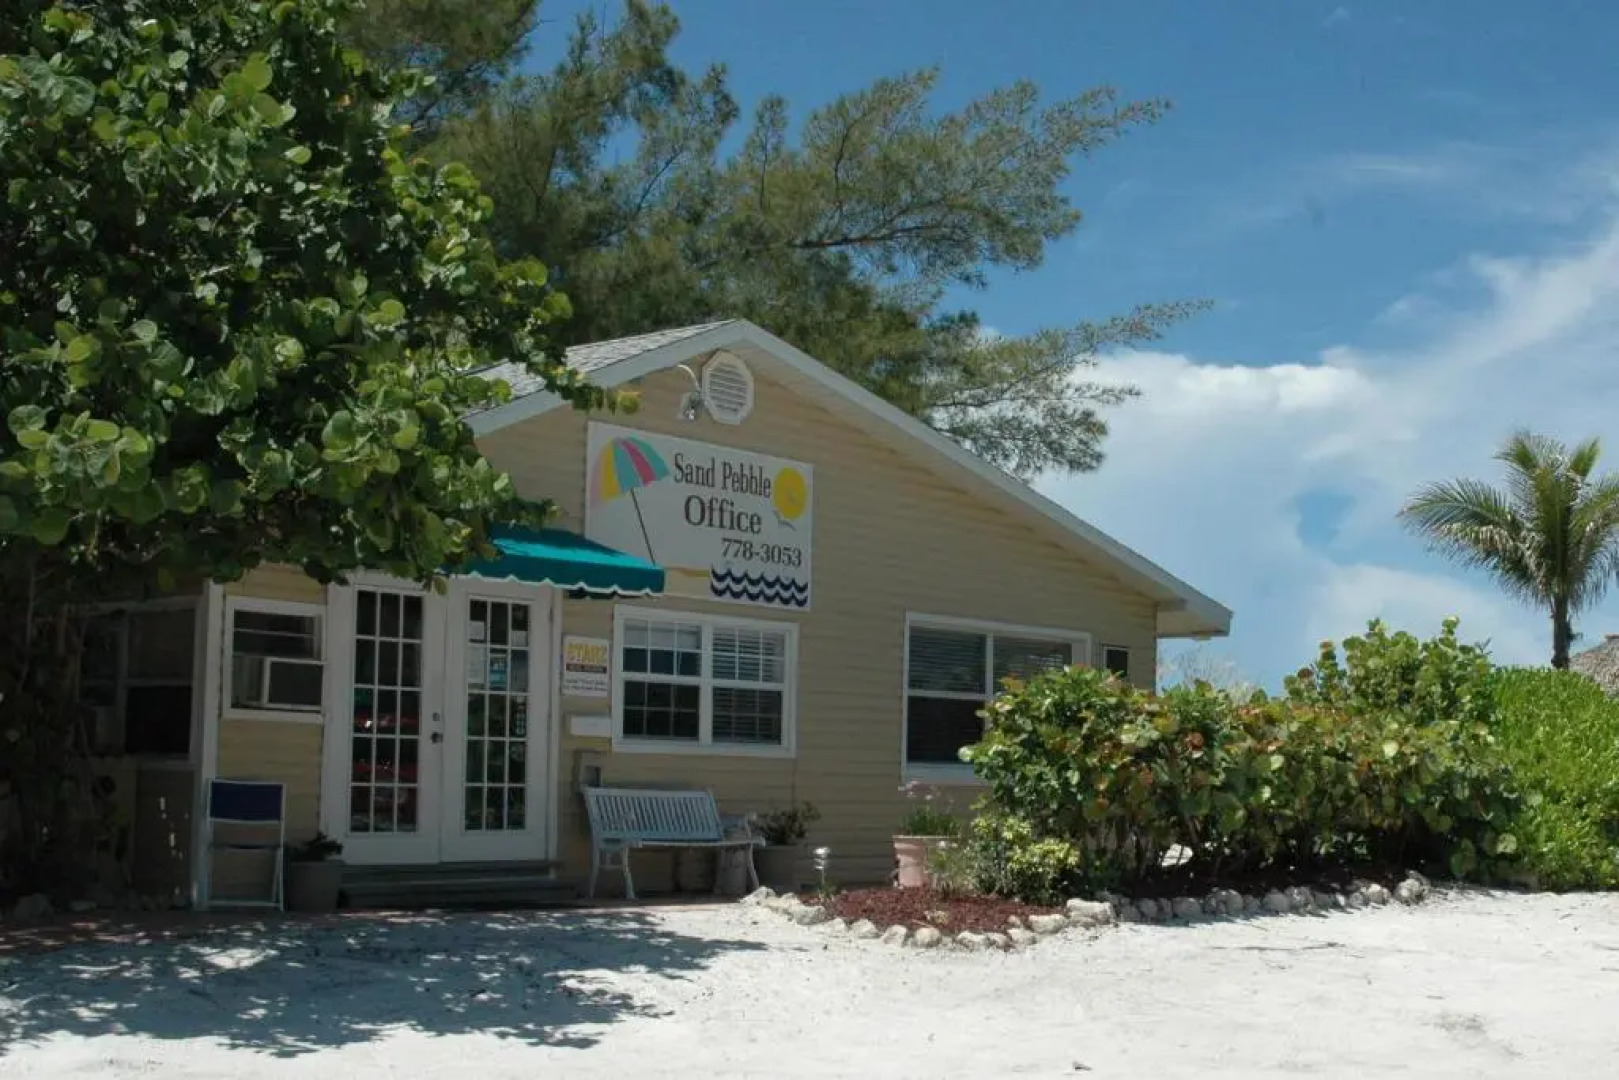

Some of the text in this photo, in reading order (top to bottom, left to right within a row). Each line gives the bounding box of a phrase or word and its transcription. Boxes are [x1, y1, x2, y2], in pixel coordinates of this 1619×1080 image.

[673, 453, 771, 498] Sand Pebble
[684, 495, 762, 534] Office
[721, 538, 802, 567] 778-3053
